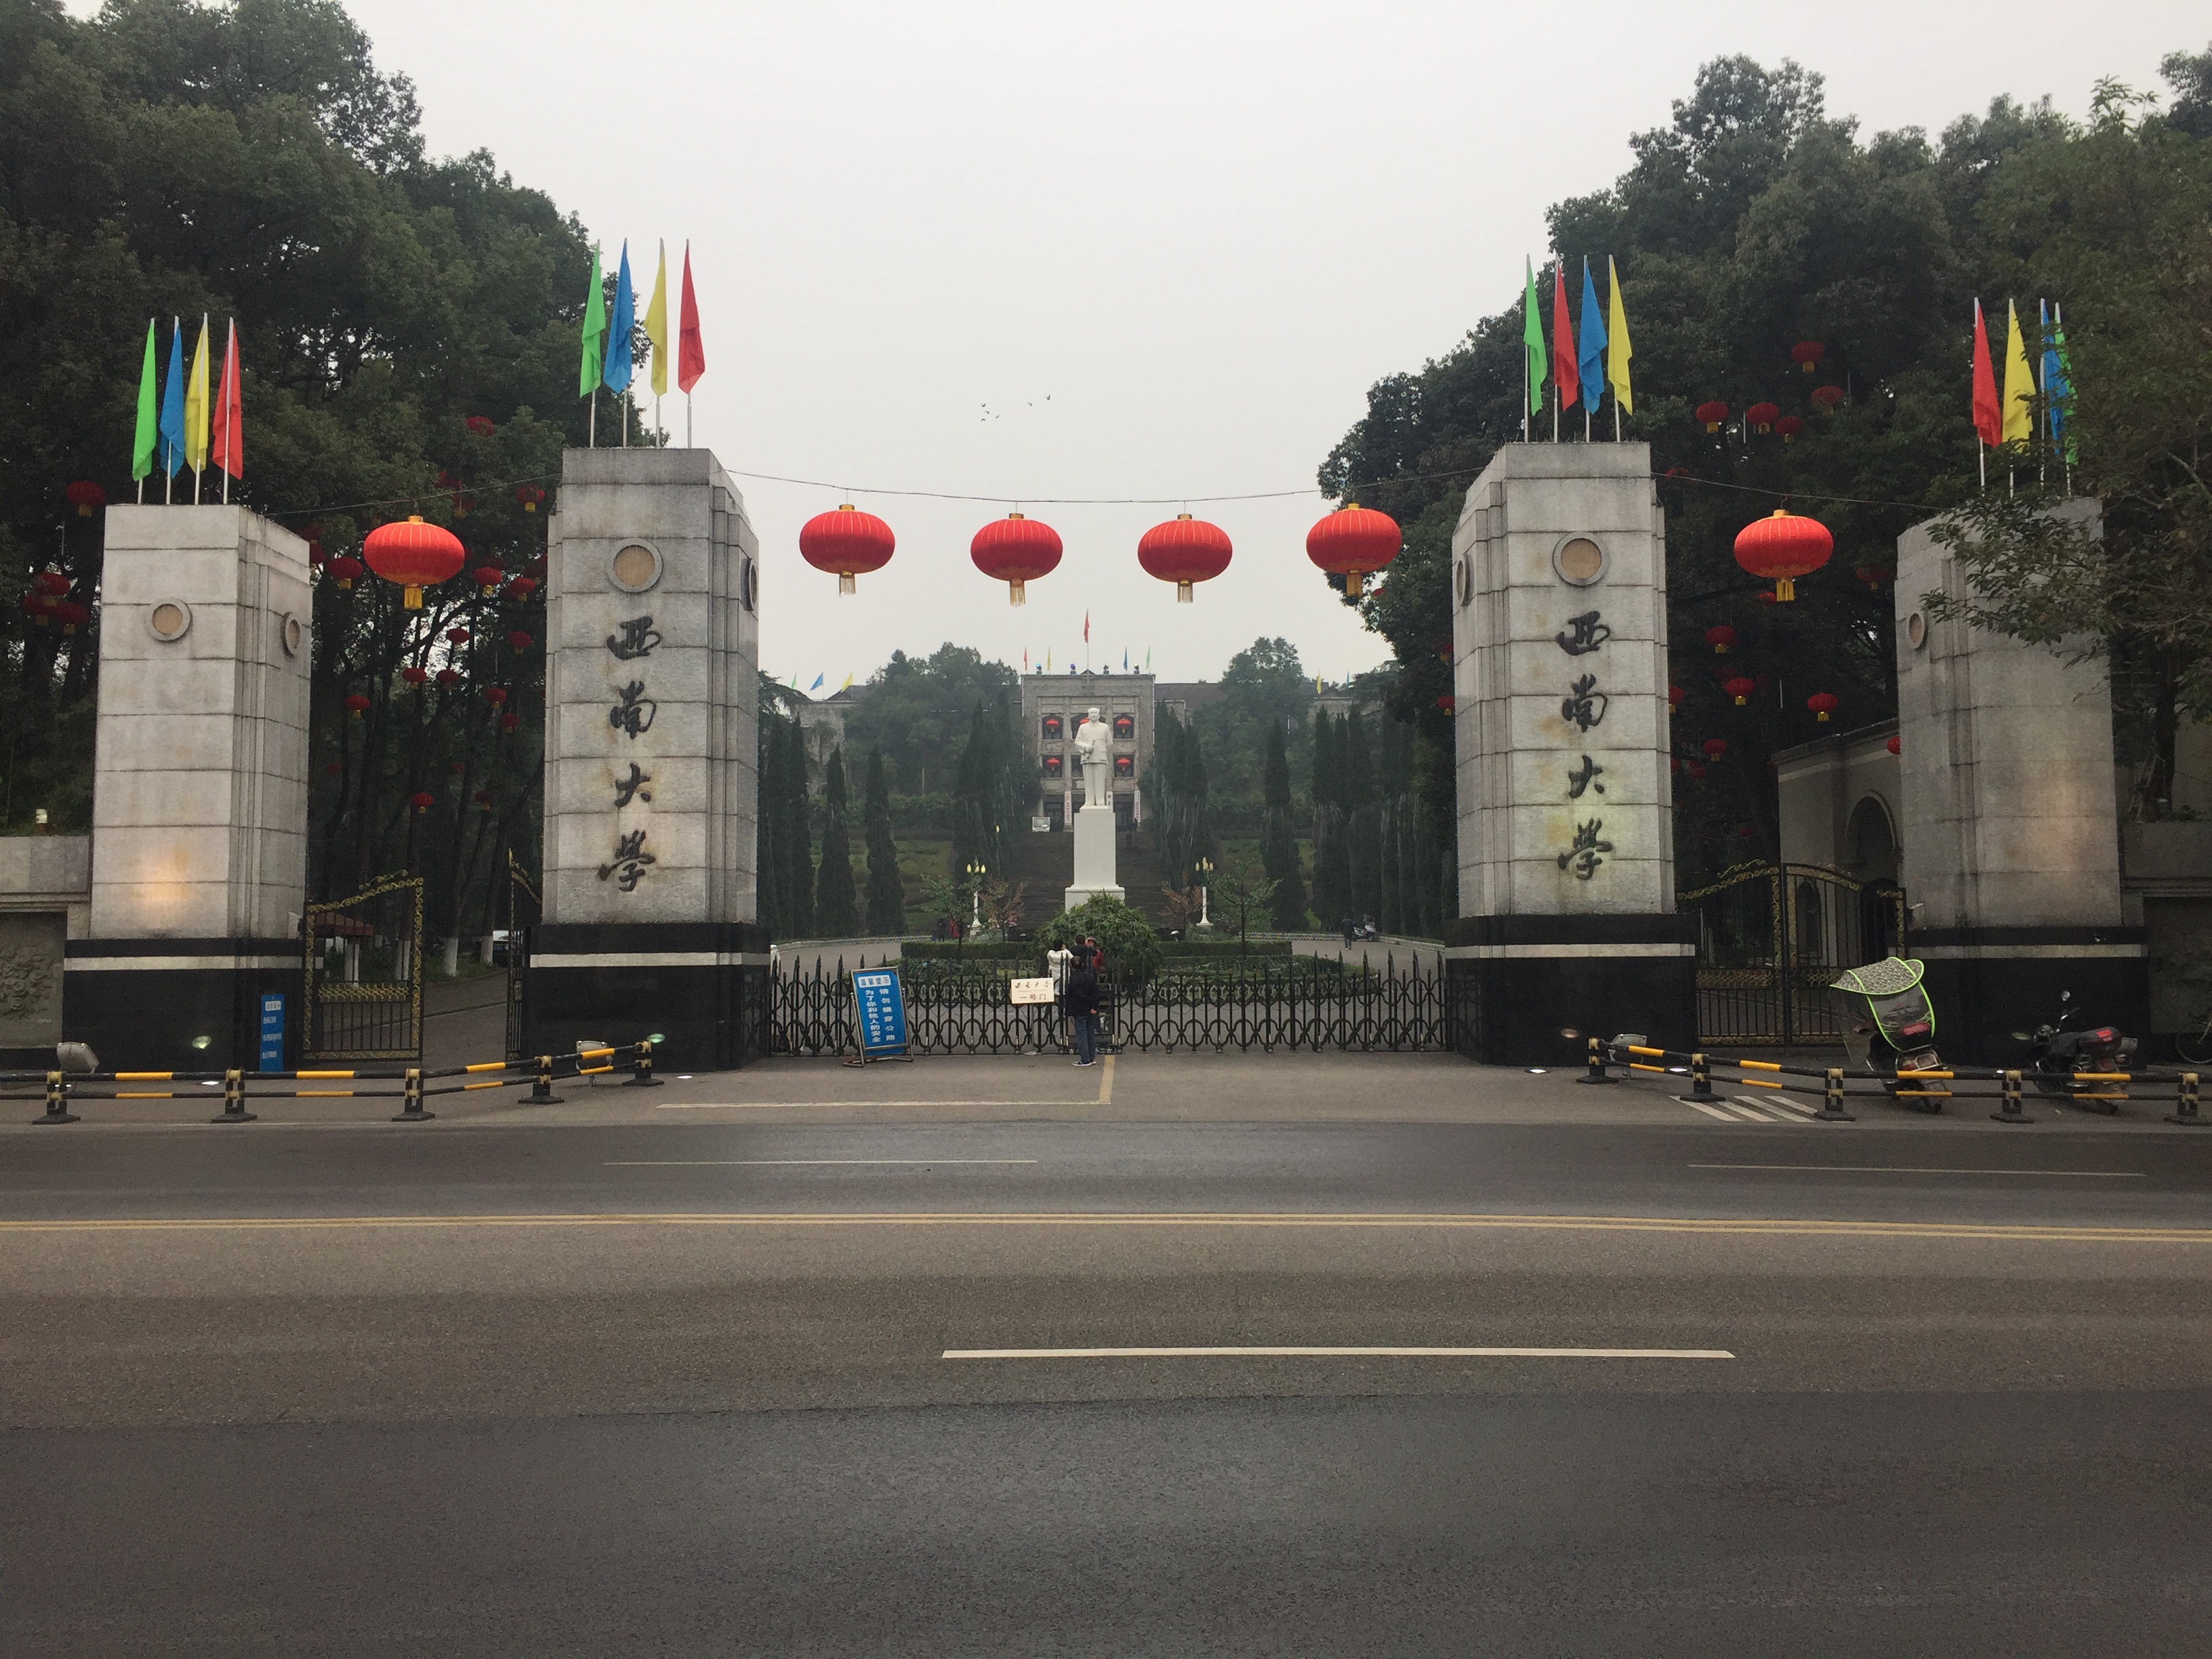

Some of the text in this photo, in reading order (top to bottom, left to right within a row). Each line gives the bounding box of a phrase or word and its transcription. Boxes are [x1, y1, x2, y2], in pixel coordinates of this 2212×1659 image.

[860, 977, 890, 986] 温馨提示
[879, 988, 895, 1041] 请勿横穿公路
